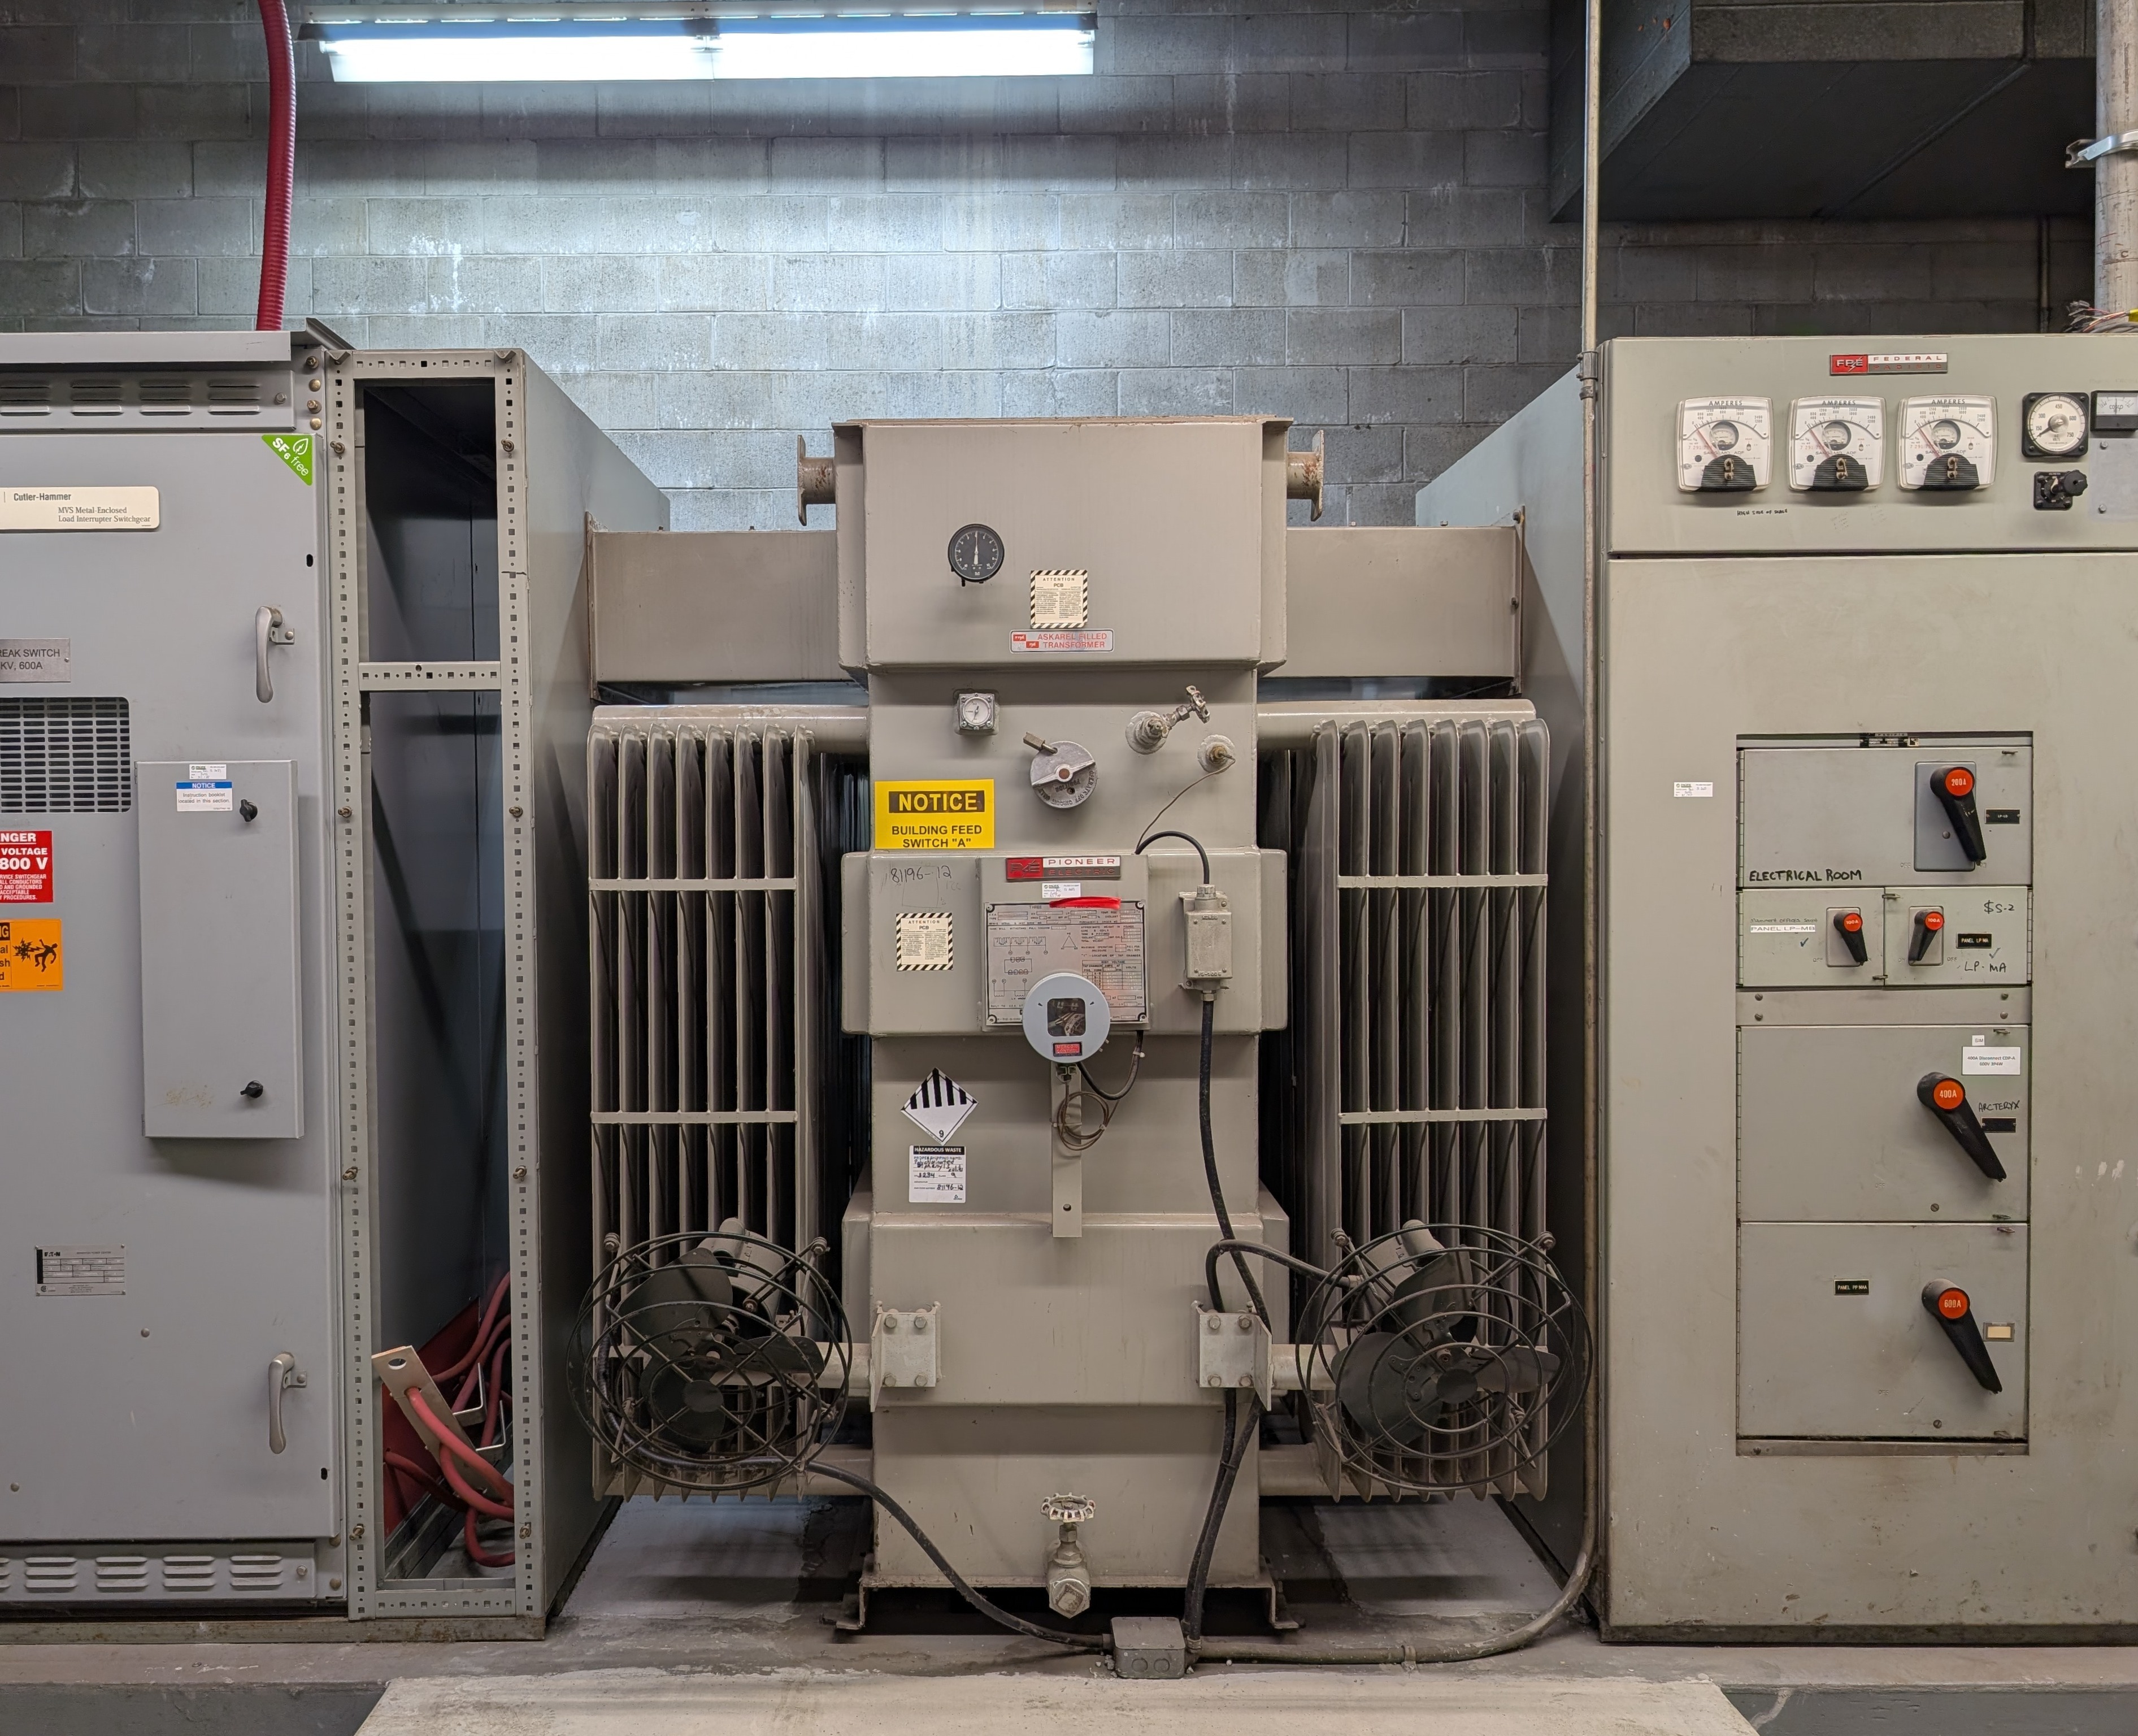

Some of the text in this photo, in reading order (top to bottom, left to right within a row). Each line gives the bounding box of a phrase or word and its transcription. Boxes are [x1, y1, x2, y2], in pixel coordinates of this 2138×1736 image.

[290, 456, 308, 476] free
[114, 515, 151, 524] Switchgear
[23, 649, 60, 657] SWITCH
[19, 661, 43, 670] 600A
[899, 793, 977, 811] NOTICE
[892, 825, 982, 835] BUILDING FEED
[0, 833, 36, 842] NGER
[903, 838, 971, 848] SWITCH "A"
[36, 857, 49, 870] V
[1749, 869, 1862, 882] ELECTRICAL ROOM
[1979, 1100, 2020, 1112] ARCTERYX
